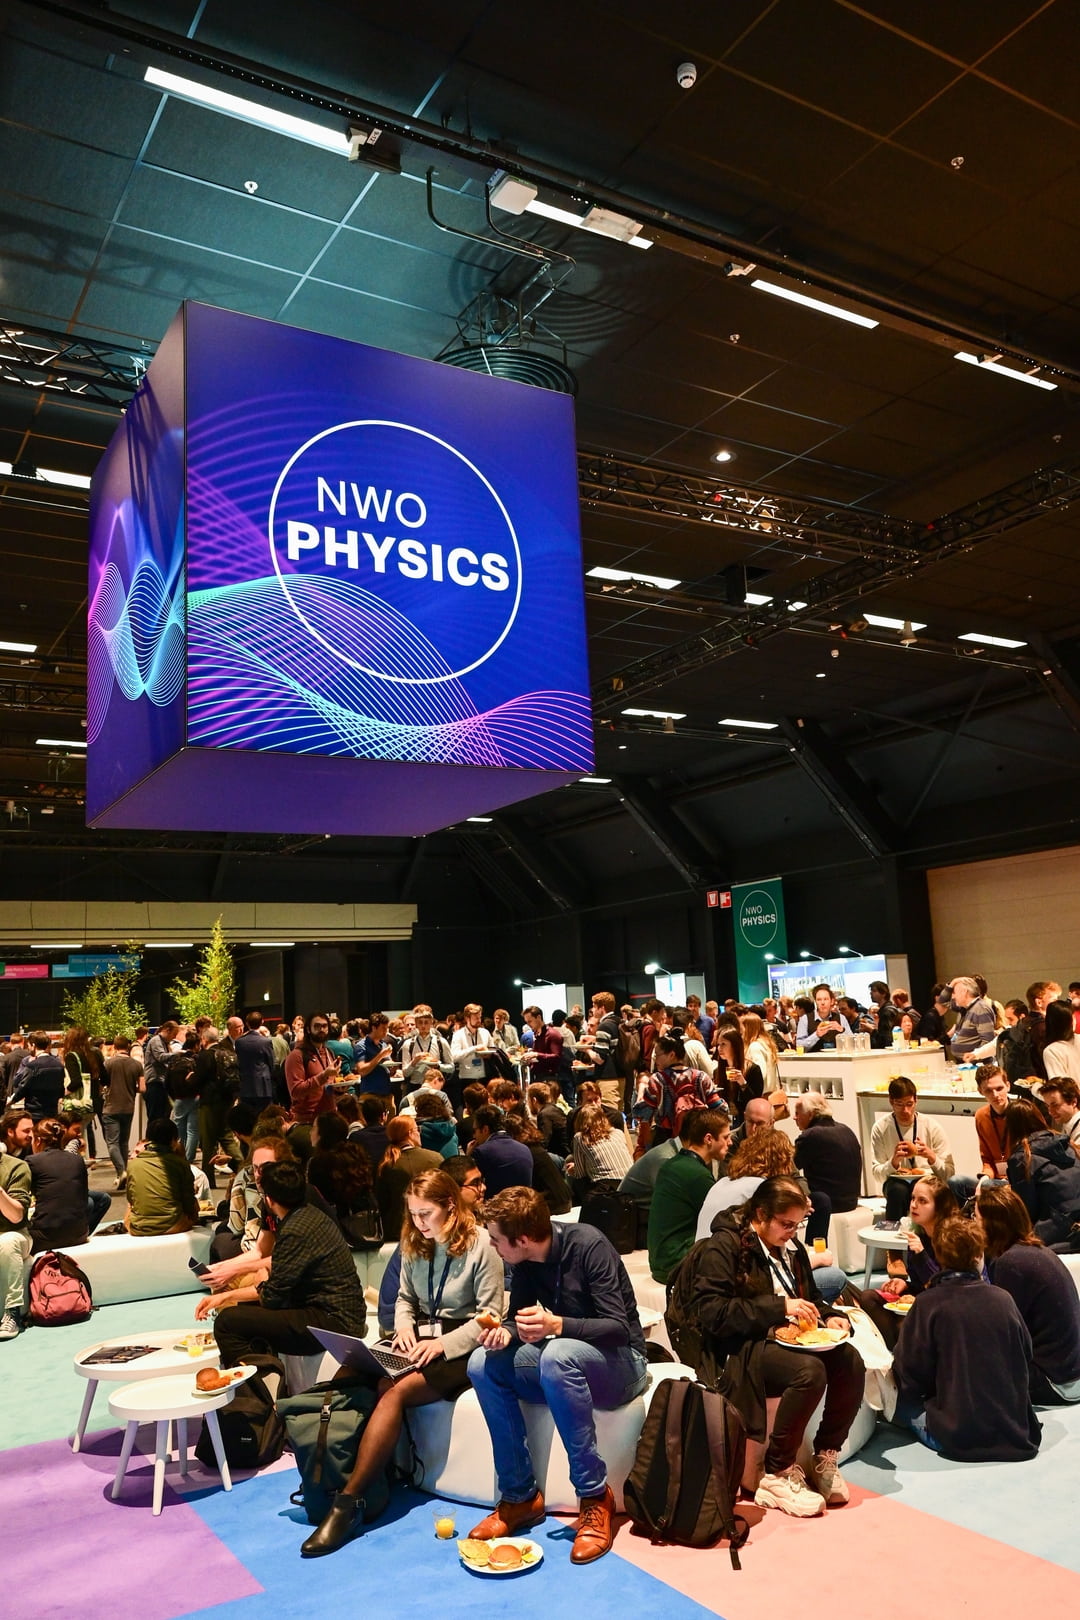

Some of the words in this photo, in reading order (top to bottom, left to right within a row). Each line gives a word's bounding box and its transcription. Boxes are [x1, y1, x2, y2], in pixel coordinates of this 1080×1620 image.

[317, 476, 427, 529] NWO
[287, 520, 510, 592] PHYSICS
[742, 913, 776, 927] PHYSICS
[745, 905, 763, 915] NWO
